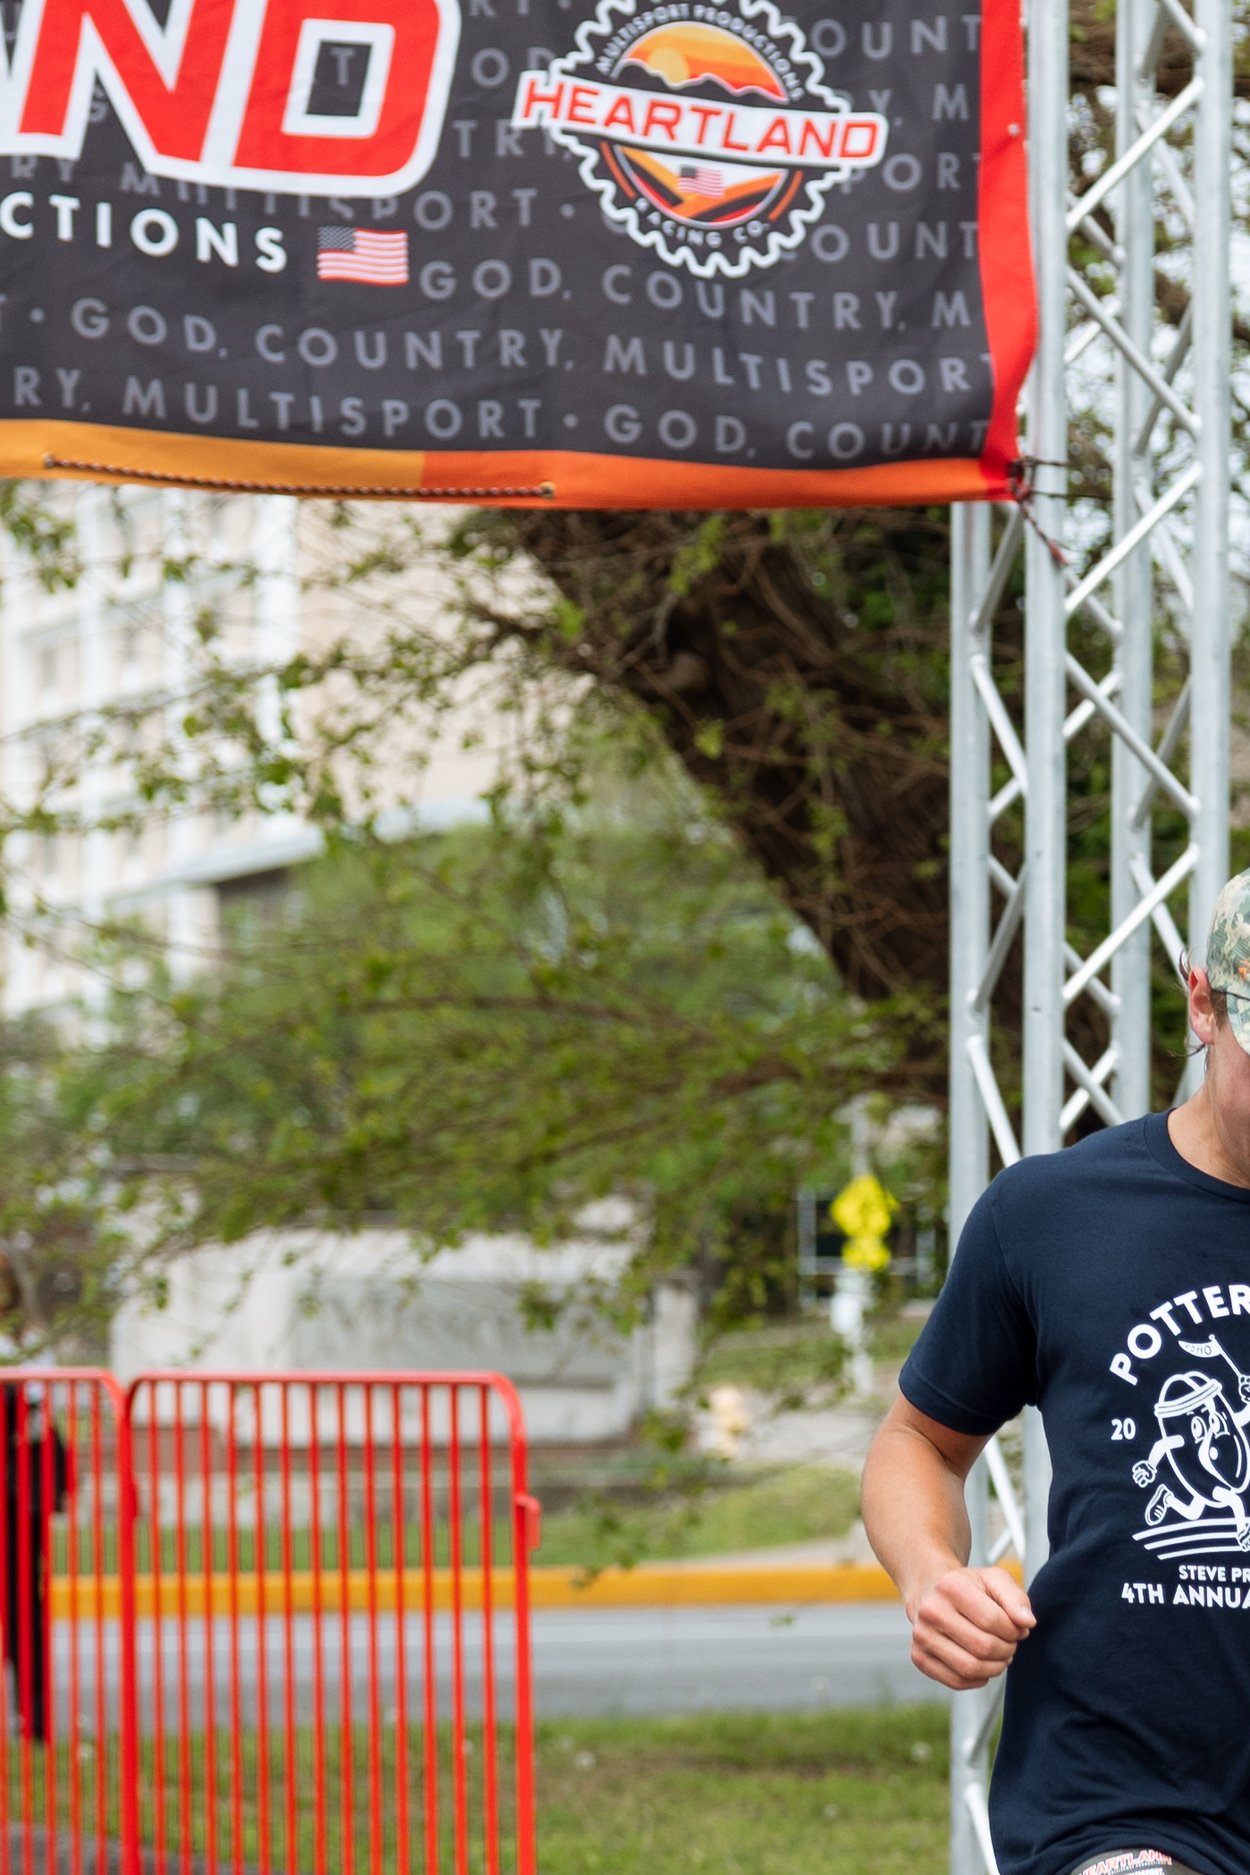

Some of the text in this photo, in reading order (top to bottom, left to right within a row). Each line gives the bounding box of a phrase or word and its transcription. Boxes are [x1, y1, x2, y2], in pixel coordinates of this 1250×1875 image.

[597, 3, 804, 100] MULTISPORT PRODUCTIONS
[518, 77, 882, 160] HEARTLAND
[0, 191, 287, 273] CTIONS
[122, 375, 540, 438] MULTISPORT
[1110, 1418, 1136, 1440] 20
[1121, 1582, 1165, 1605] 4TH
[1178, 1565, 1226, 1582] STEVE
